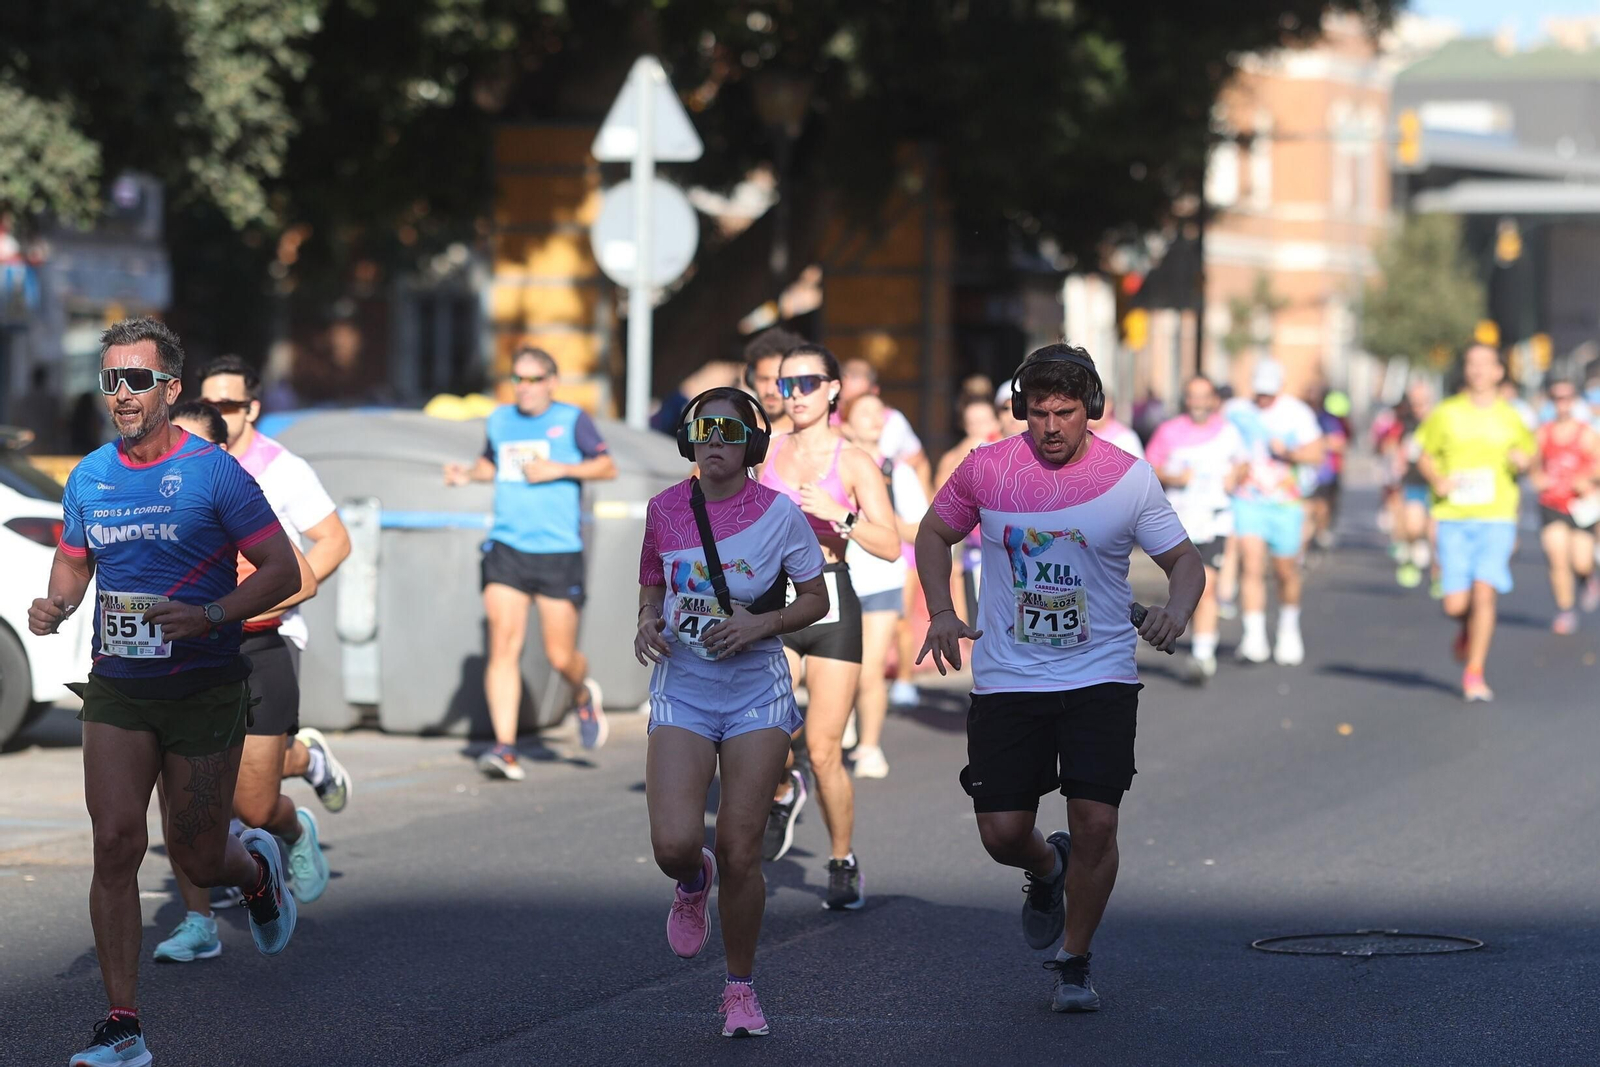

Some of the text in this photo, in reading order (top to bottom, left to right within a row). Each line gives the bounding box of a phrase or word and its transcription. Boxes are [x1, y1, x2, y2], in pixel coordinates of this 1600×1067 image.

[124, 508, 131, 516] A
[133, 505, 172, 515] CORRER
[1034, 561, 1082, 587] XII 10k
[1034, 584, 1060, 592] CARRERA
[104, 594, 118, 609] XII
[680, 597, 705, 611] XII
[1023, 592, 1042, 605] XII
[1052, 597, 1077, 608] 2025
[106, 614, 156, 638] 551
[1025, 609, 1079, 632] 713
